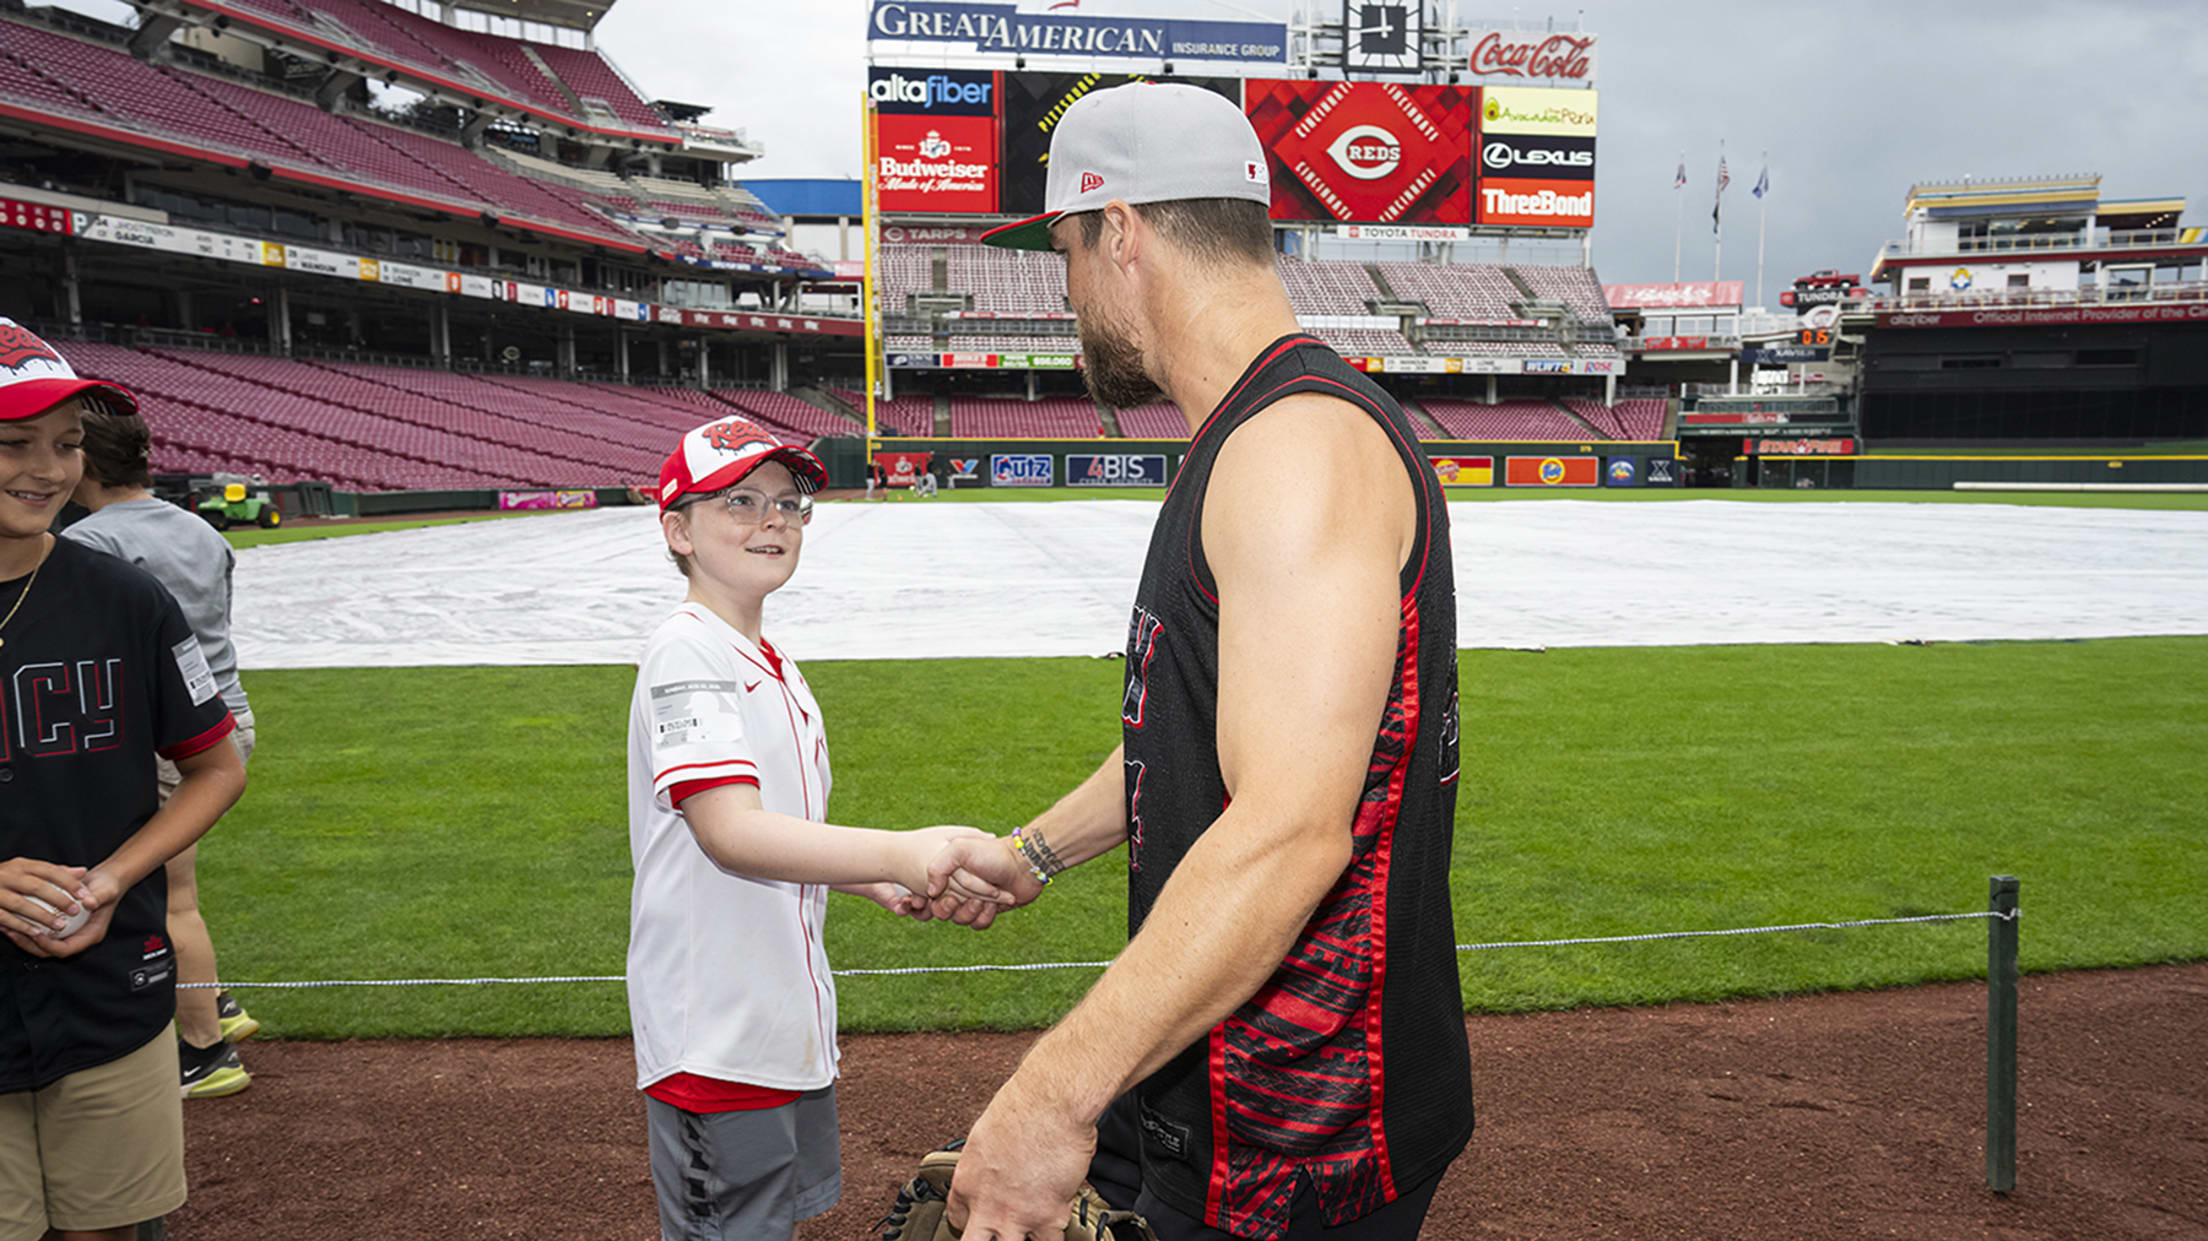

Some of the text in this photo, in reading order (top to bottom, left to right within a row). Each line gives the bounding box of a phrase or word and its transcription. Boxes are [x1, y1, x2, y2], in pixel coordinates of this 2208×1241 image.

[875, 4, 996, 37] GREAT
[1172, 42, 1238, 57] INSURANCE
[1240, 45, 1281, 58] GROUP
[1470, 32, 1597, 79] Coca-Cola
[870, 73, 993, 109] altafiber
[1348, 145, 1402, 162] REDS
[1513, 149, 1594, 166] LEXUS
[879, 156, 989, 179] Budweiser
[1482, 188, 1593, 217] ThreeBond
[907, 227, 967, 240] TARPS
[1364, 227, 1457, 239] TOYOTA TUNDRA
[1798, 290, 1845, 303] TUNDRA
[1972, 311, 2023, 324] Official
[2024, 309, 2081, 322] Internet
[2081, 307, 2140, 320] Provider
[2142, 306, 2160, 319] of
[2160, 306, 2186, 319] the
